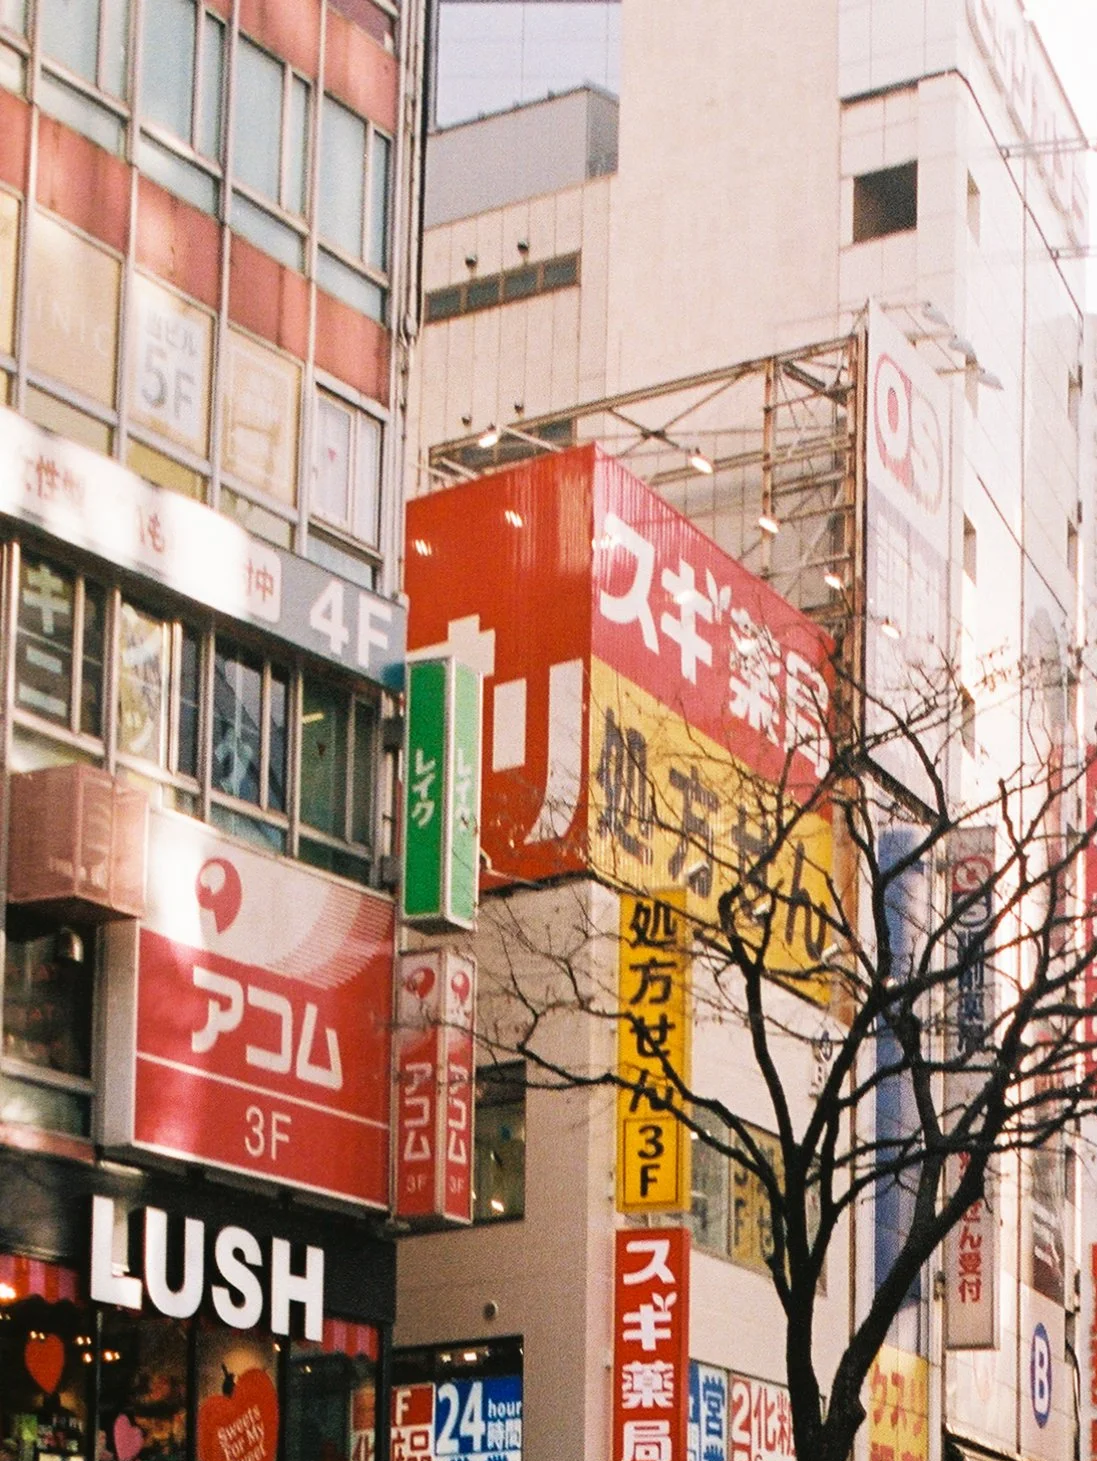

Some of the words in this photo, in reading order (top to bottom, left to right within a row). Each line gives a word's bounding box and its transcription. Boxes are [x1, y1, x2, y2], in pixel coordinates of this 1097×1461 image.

[141, 344, 197, 421] 5F
[309, 579, 393, 669] 4F
[598, 514, 832, 782] スギ薬局
[415, 750, 432, 827] レイク
[191, 967, 343, 1091] アコム
[629, 899, 677, 1114] 処方せん
[245, 1105, 292, 1161] 3F
[403, 1062, 432, 1162] アコム
[448, 1062, 469, 1164] アコム
[405, 1174, 428, 1194] 3F
[449, 1173, 465, 1194] 3F
[637, 1124, 665, 1199] 3F
[91, 1195, 325, 1342] LUSH
[437, 1381, 486, 1455] 24
[488, 1398, 521, 1418] hour
